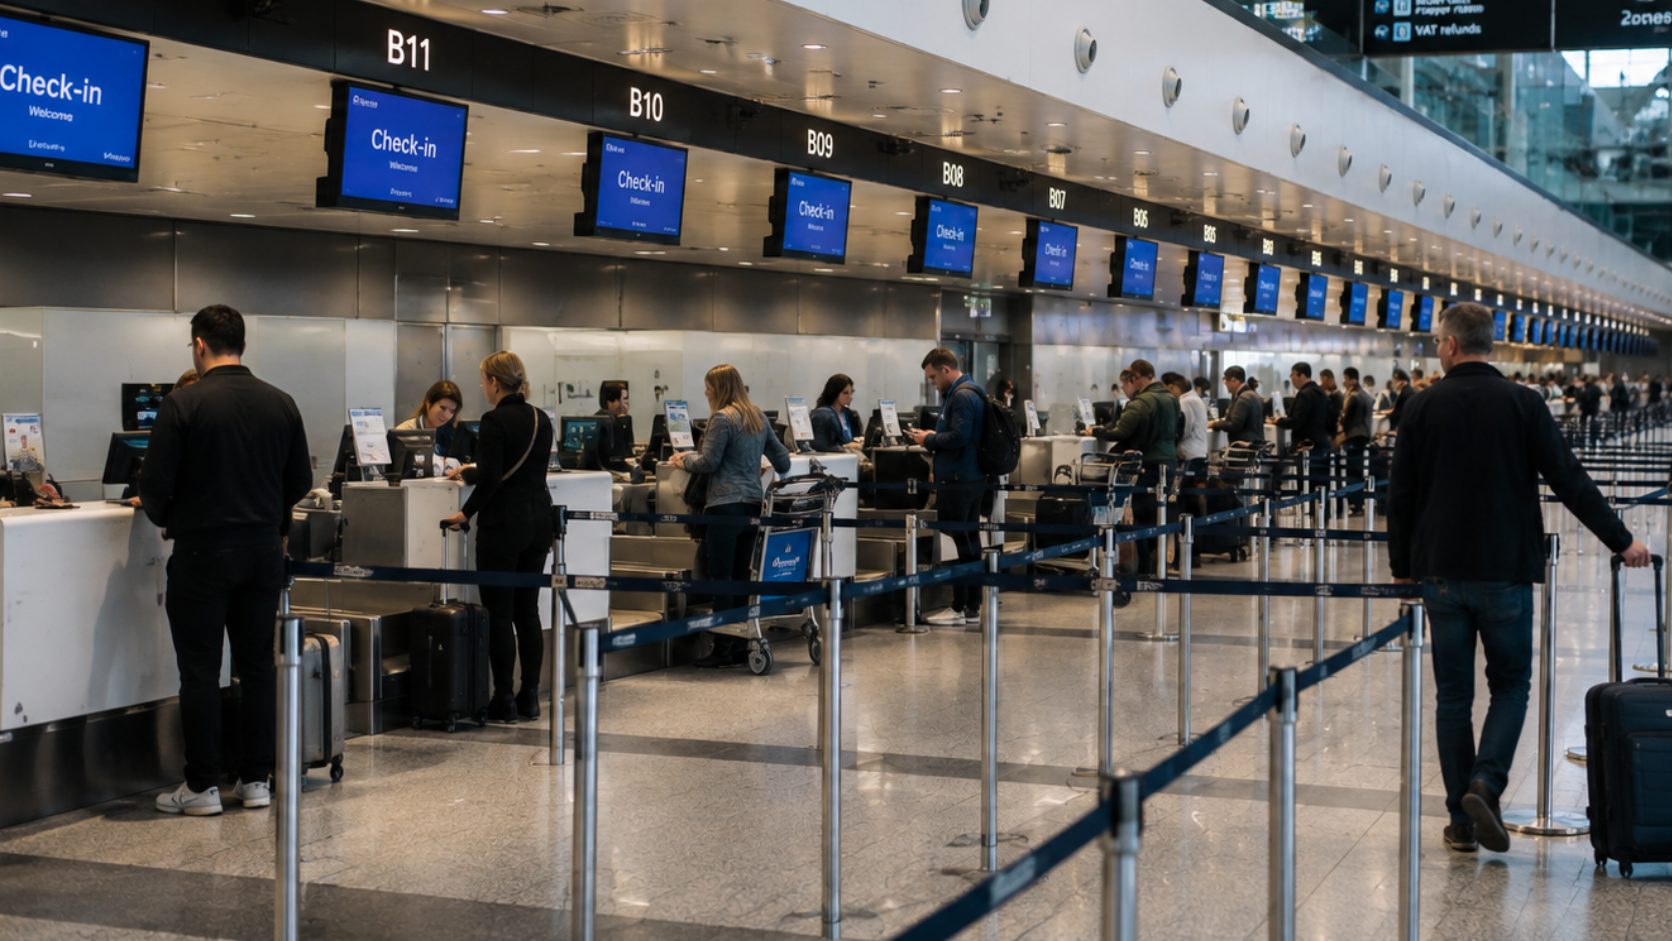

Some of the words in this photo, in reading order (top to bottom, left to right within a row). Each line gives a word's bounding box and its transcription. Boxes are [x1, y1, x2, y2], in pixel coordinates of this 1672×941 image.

[1415, 24, 1438, 36] VAT
[1440, 23, 1482, 36] refunds
[387, 28, 431, 71] B11
[0, 64, 102, 105] Check-in
[629, 86, 664, 122] B10
[371, 128, 437, 158] Check-in
[807, 128, 834, 158] B09
[617, 169, 665, 194] Check-in
[942, 161, 964, 188] B08
[798, 200, 834, 220] Check-in
[1049, 187, 1067, 210] B07
[936, 224, 965, 241] Check-in
